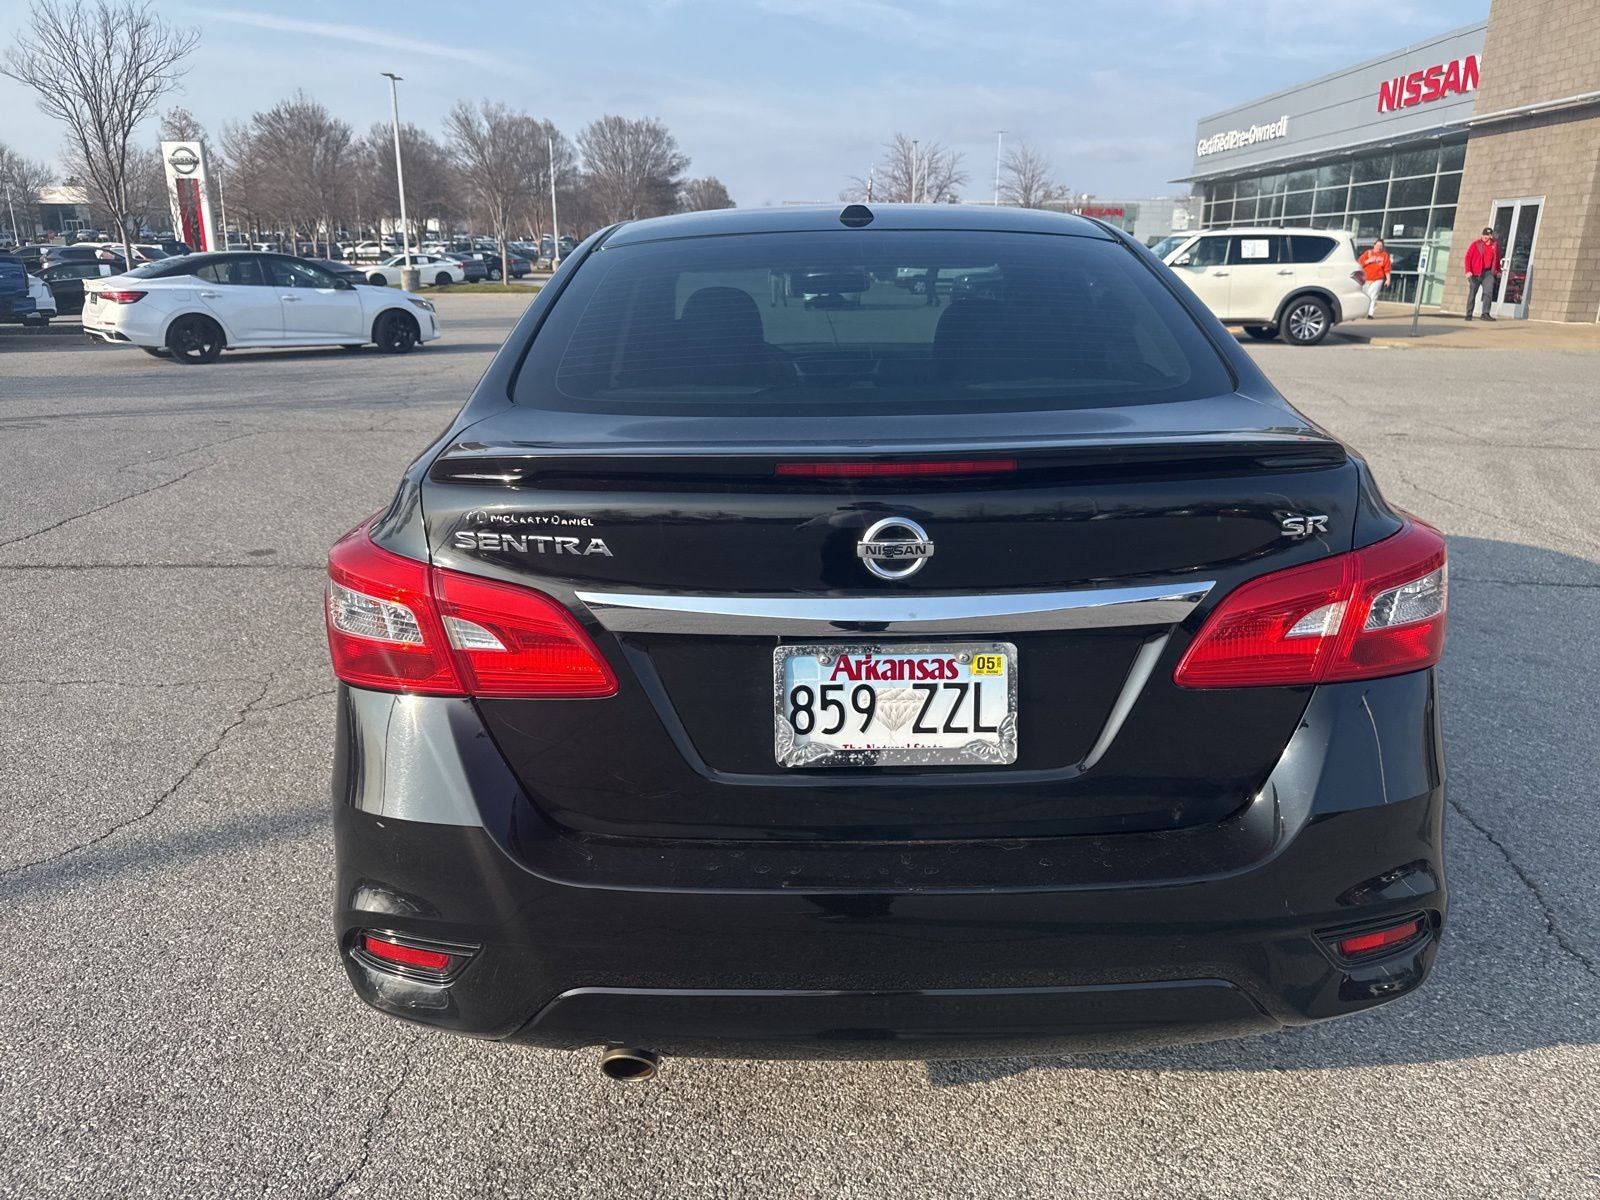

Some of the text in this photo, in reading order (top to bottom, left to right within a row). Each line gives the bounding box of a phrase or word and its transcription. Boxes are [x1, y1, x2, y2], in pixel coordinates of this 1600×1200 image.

[1377, 54, 1479, 113] NISSAN
[1197, 131, 1230, 156] Certified
[551, 514, 594, 526] DANIEL
[1281, 515, 1328, 536] SR
[454, 531, 614, 557] SENTRA
[865, 545, 926, 557] NISSAN
[829, 654, 960, 681] Arkansas
[977, 656, 996, 670] 05
[789, 682, 998, 736] 859 ZZL
